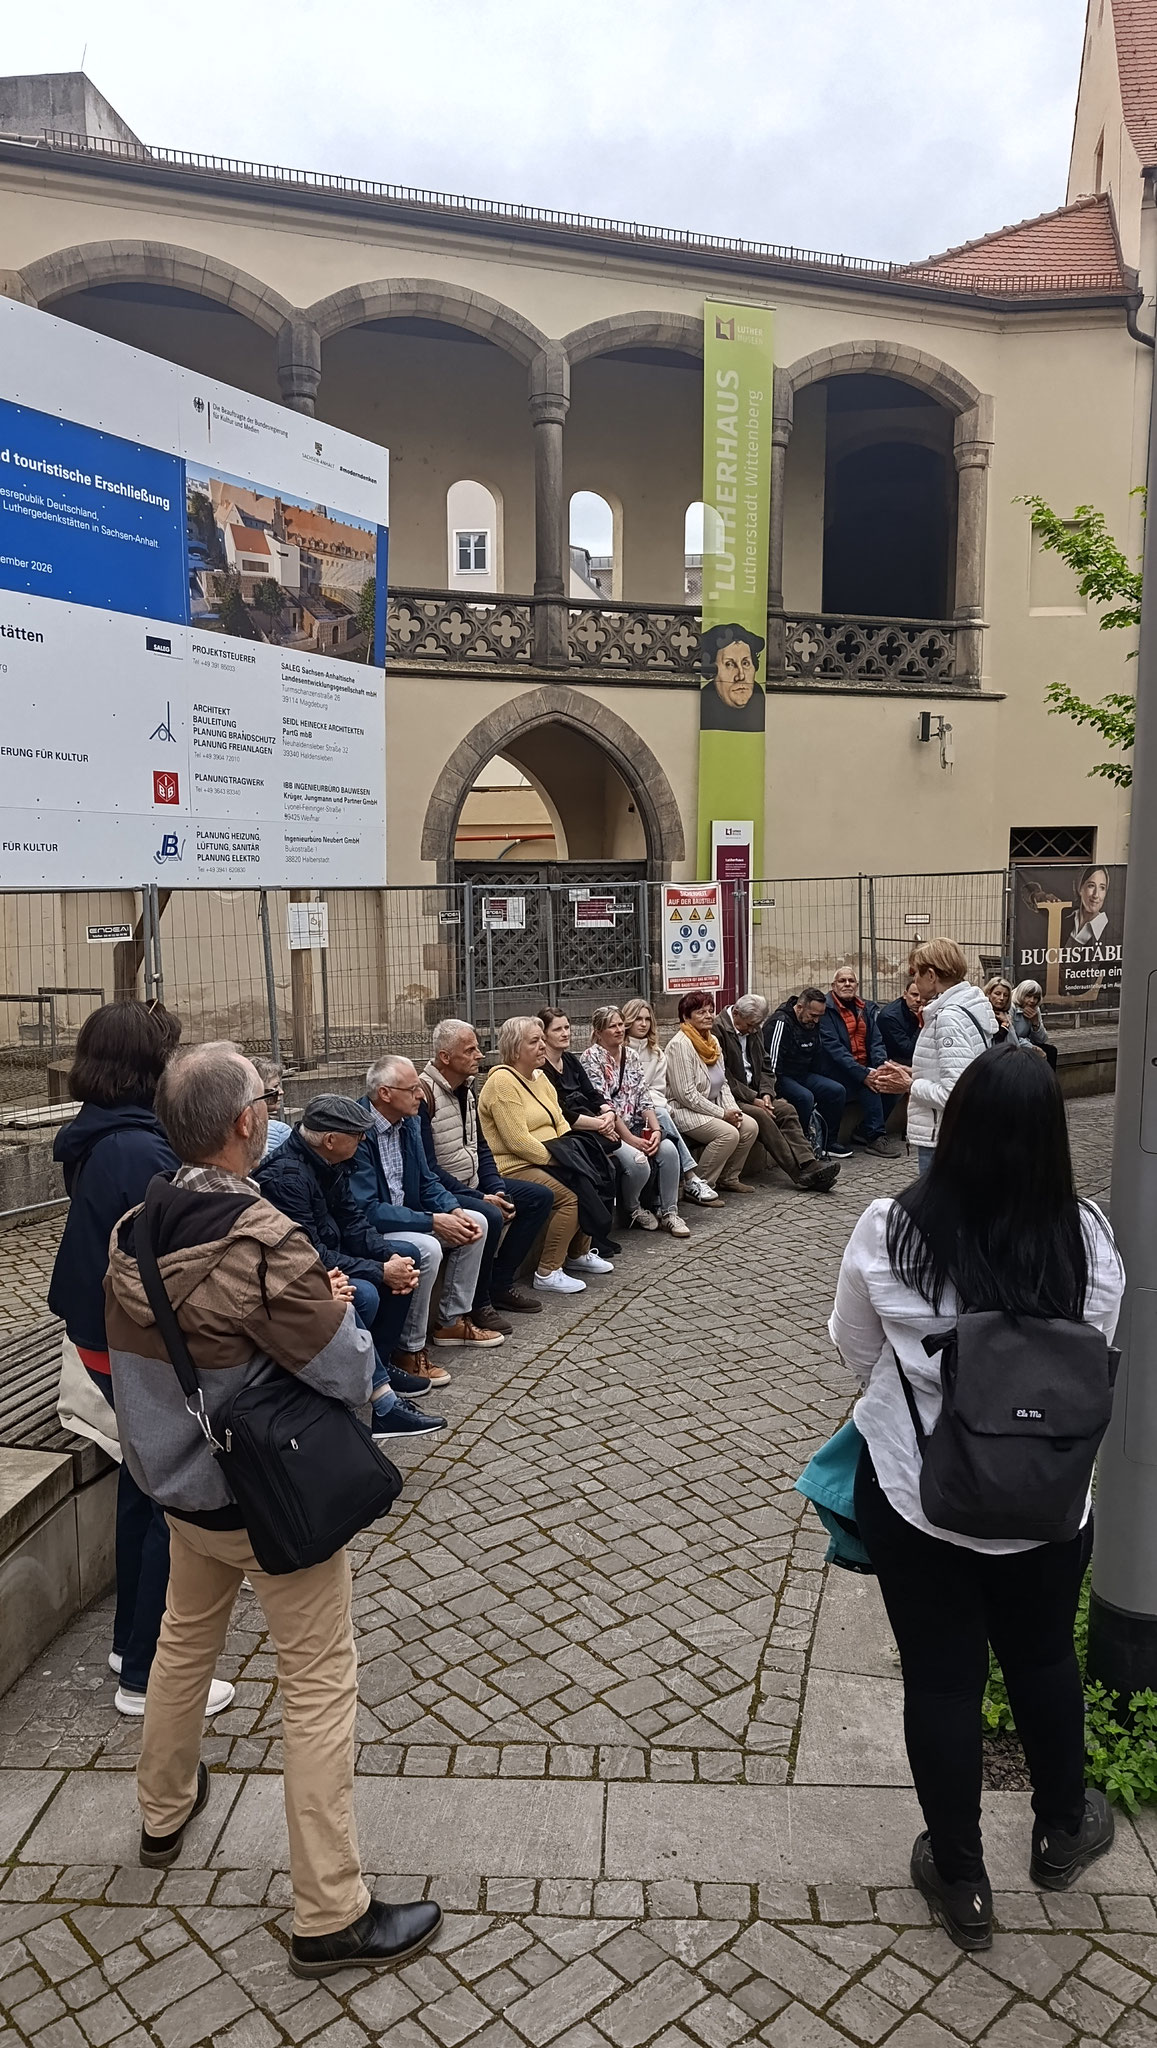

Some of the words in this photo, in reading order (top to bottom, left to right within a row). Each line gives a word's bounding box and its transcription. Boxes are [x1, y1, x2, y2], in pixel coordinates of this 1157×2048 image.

[738, 326, 763, 336] LUTHER
[213, 402, 221, 411] Die
[221, 406, 246, 422] Beauftragte
[246, 415, 254, 424] der
[254, 418, 289, 438] Bundesregierung
[220, 415, 234, 426] Kultur
[234, 420, 243, 429] und
[244, 423, 260, 434] Medien
[744, 390, 763, 486] Wittenberg
[14, 452, 91, 486] touristische
[94, 475, 170, 511] Erschließung
[715, 370, 739, 590] LUTHERHAUS
[0, 487, 45, 506] esrepublik
[47, 498, 100, 521] Deutschland,
[3, 500, 90, 531] Luthergedenkstätten
[92, 524, 99, 533] in
[101, 525, 160, 549] Sachsen-Anhalt.
[743, 493, 758, 594] Lutherstadt
[0, 556, 29, 568] ember
[31, 561, 53, 574] 2026
[153, 644, 170, 653] SALEG
[192, 645, 256, 664] PROJEKTSTEUERER
[281, 662, 301, 673] SALEG
[301, 666, 356, 684] Sachsen-Anhaltische
[281, 673, 365, 696] Landesentwicklungsgesellschaft
[365, 689, 377, 698] mbH
[193, 703, 231, 716] ARCHITEKT
[299, 698, 329, 711] Magdeburg
[193, 715, 237, 728] BAULEITUNG
[283, 717, 299, 726] SEIDL
[300, 720, 327, 730] HEINECKE
[328, 724, 365, 736] ARCHITEKTEN
[193, 727, 227, 738] PLANUNG
[228, 731, 276, 744] BRANDSCHUTZ
[283, 728, 299, 737] PartG
[193, 739, 228, 750] PLANUNG
[228, 742, 273, 755] FREIANLAGEN
[325, 744, 342, 753] Straße
[1, 746, 33, 759] ERUNG
[36, 748, 53, 760] FÜR
[55, 751, 89, 763] KULTUR
[300, 752, 333, 762] Haldensleben
[195, 773, 228, 784] PLANUNG
[229, 776, 265, 786] TRAGWERK
[283, 782, 293, 790] IBB
[294, 783, 340, 793] INGENIEURBÜRO
[341, 787, 370, 796] BAUWESEN
[283, 792, 303, 801] Krüger,
[304, 794, 332, 804] Jungmann
[344, 797, 362, 805] Partner
[196, 831, 230, 840] PLANUNG
[231, 832, 261, 842] HEIZUNG,
[284, 835, 322, 843] Ingenieurbüro
[2, 840, 21, 852] FÜR
[23, 842, 58, 852] KULTUR
[197, 841, 231, 851] LÜFTUNG,
[232, 843, 260, 852] SANITÄR
[197, 853, 231, 862] PLANUNG
[232, 854, 260, 863] ELEKTRO
[692, 897, 716, 905] BAUSTELLE
[1065, 967, 1106, 979] Facetten
